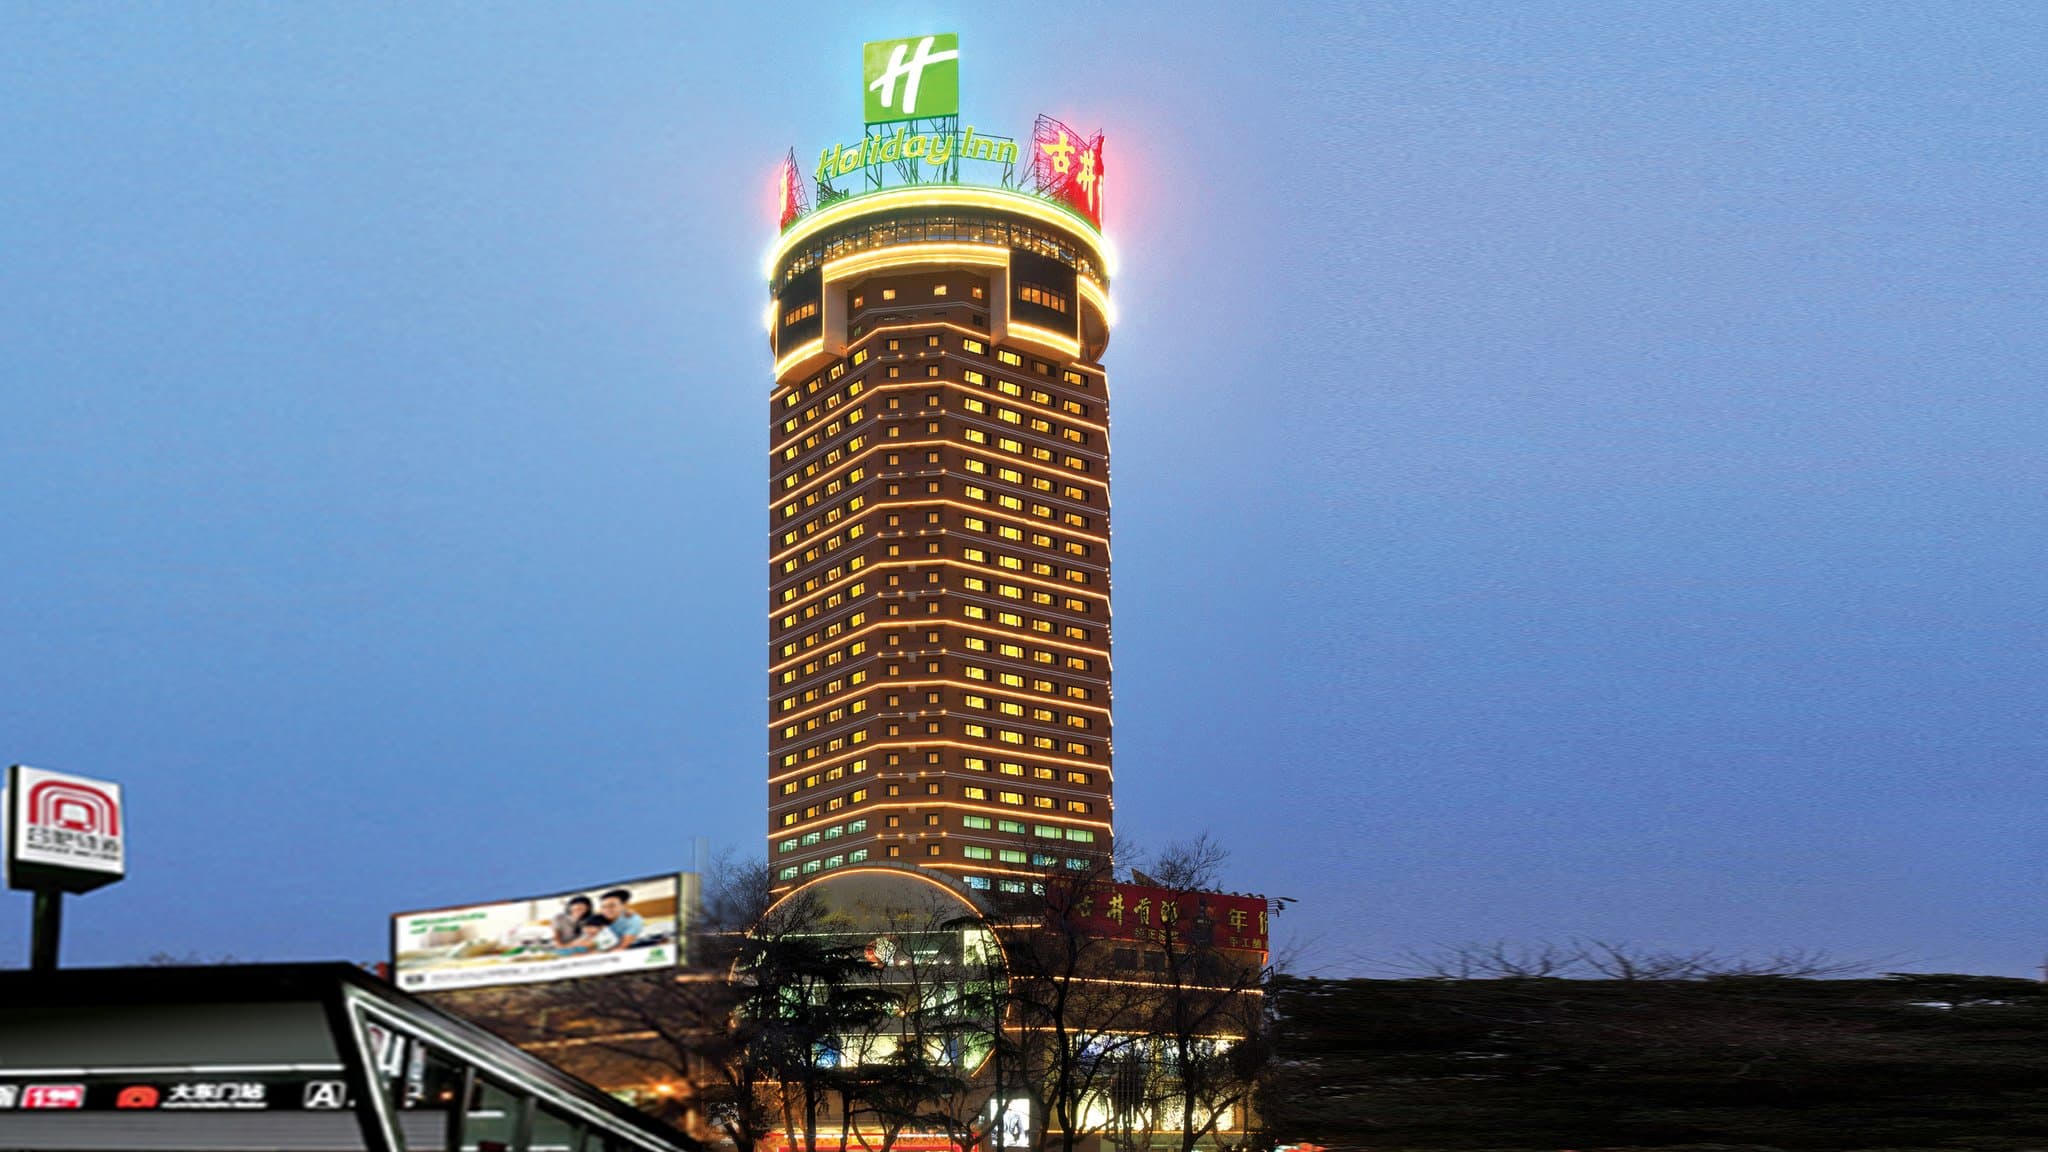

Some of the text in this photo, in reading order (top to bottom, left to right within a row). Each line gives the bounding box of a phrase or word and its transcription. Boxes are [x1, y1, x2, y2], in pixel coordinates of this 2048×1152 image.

[816, 125, 1019, 184] Holiday Inn
[1039, 130, 1096, 213] 古井
[309, 1083, 340, 1108] A
